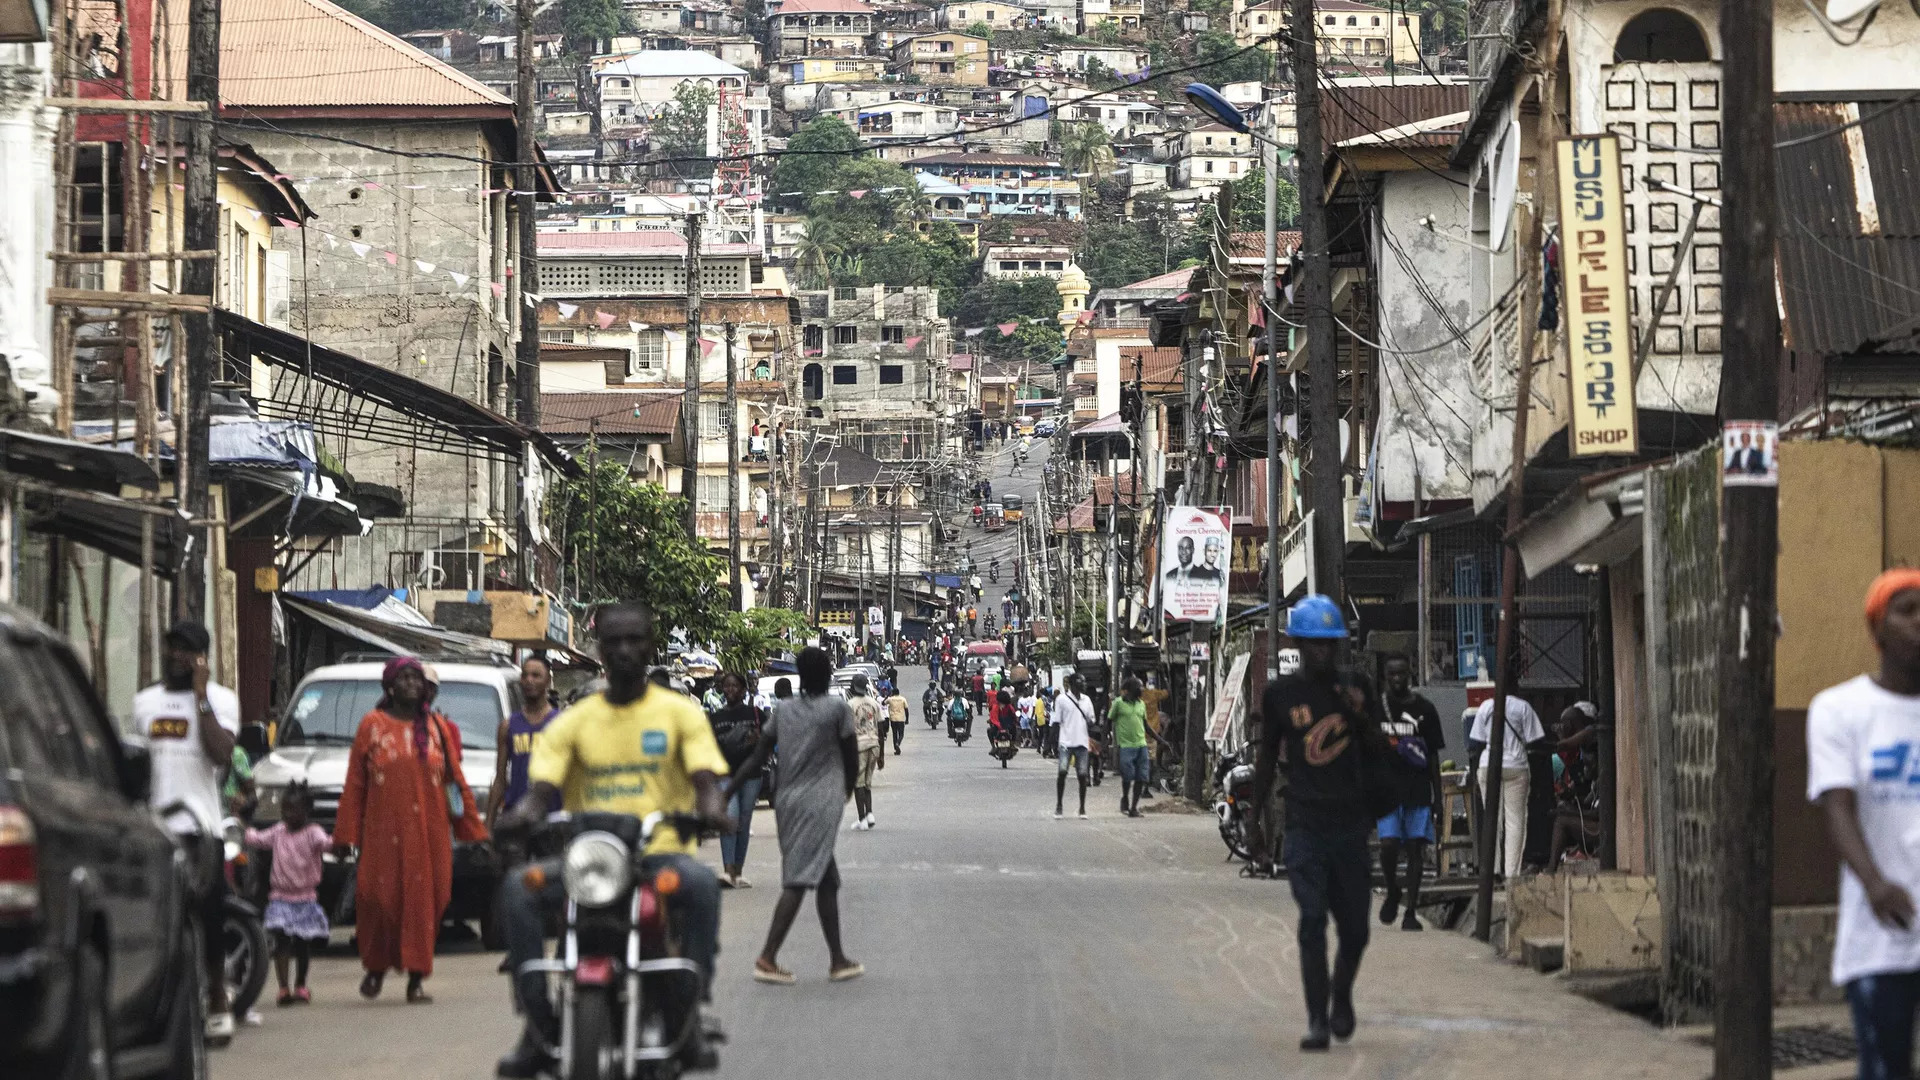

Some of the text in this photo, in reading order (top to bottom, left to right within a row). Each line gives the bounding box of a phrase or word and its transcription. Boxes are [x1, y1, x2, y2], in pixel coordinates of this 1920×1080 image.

[1572, 138, 1604, 221] MUSU
[1577, 230, 1610, 314] PELE
[1579, 429, 1628, 445] SHOP
[1279, 654, 1299, 664] MALTA
